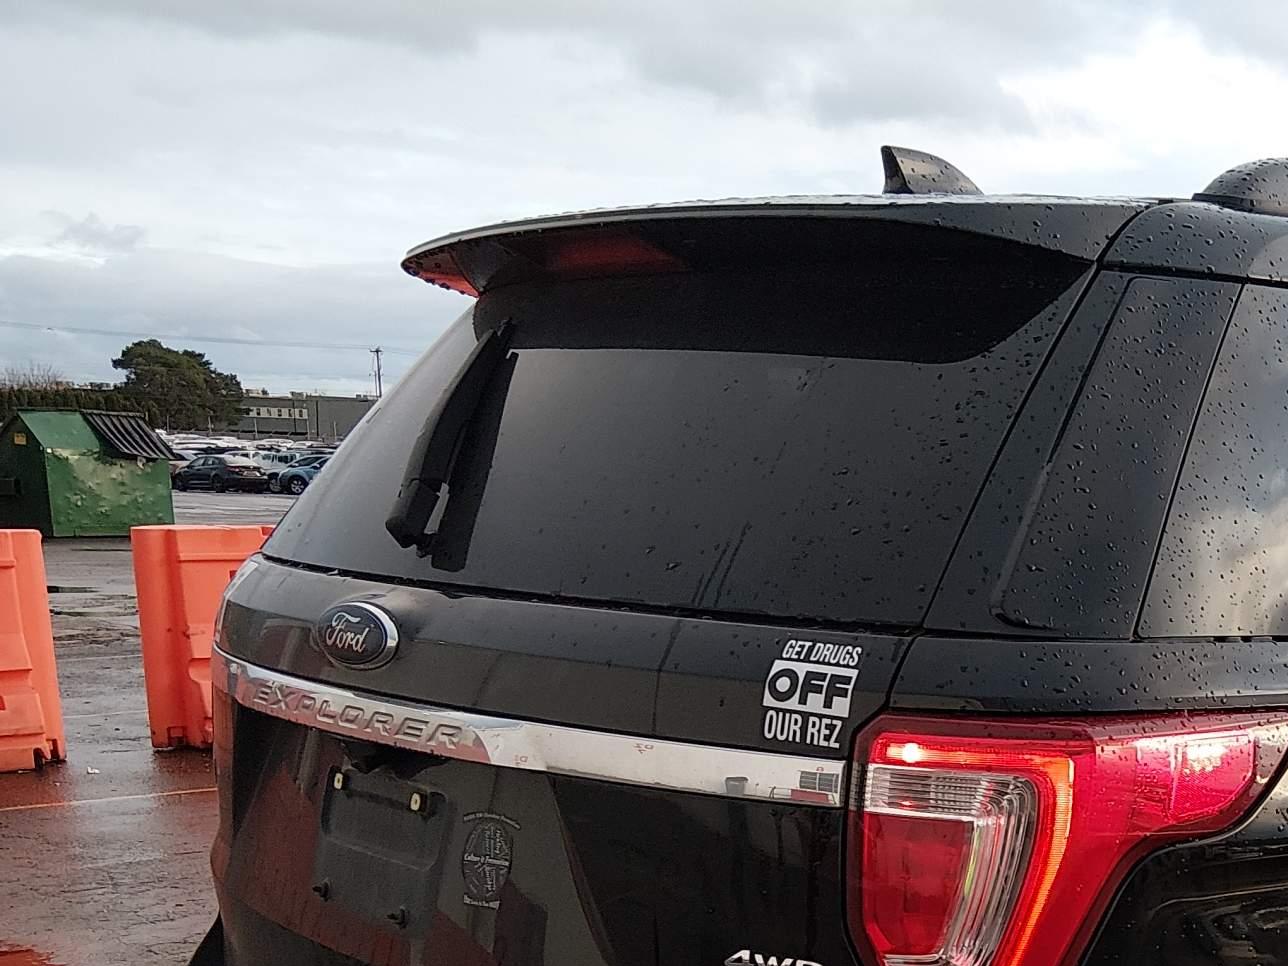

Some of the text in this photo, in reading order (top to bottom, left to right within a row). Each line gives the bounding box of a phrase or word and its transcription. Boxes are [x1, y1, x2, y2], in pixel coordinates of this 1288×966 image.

[326, 612, 370, 653] Ford
[782, 640, 862, 666] GET DRUGS
[768, 668, 853, 709] OFF
[253, 680, 464, 749] EXPLORER
[764, 710, 842, 749] OUR REZ
